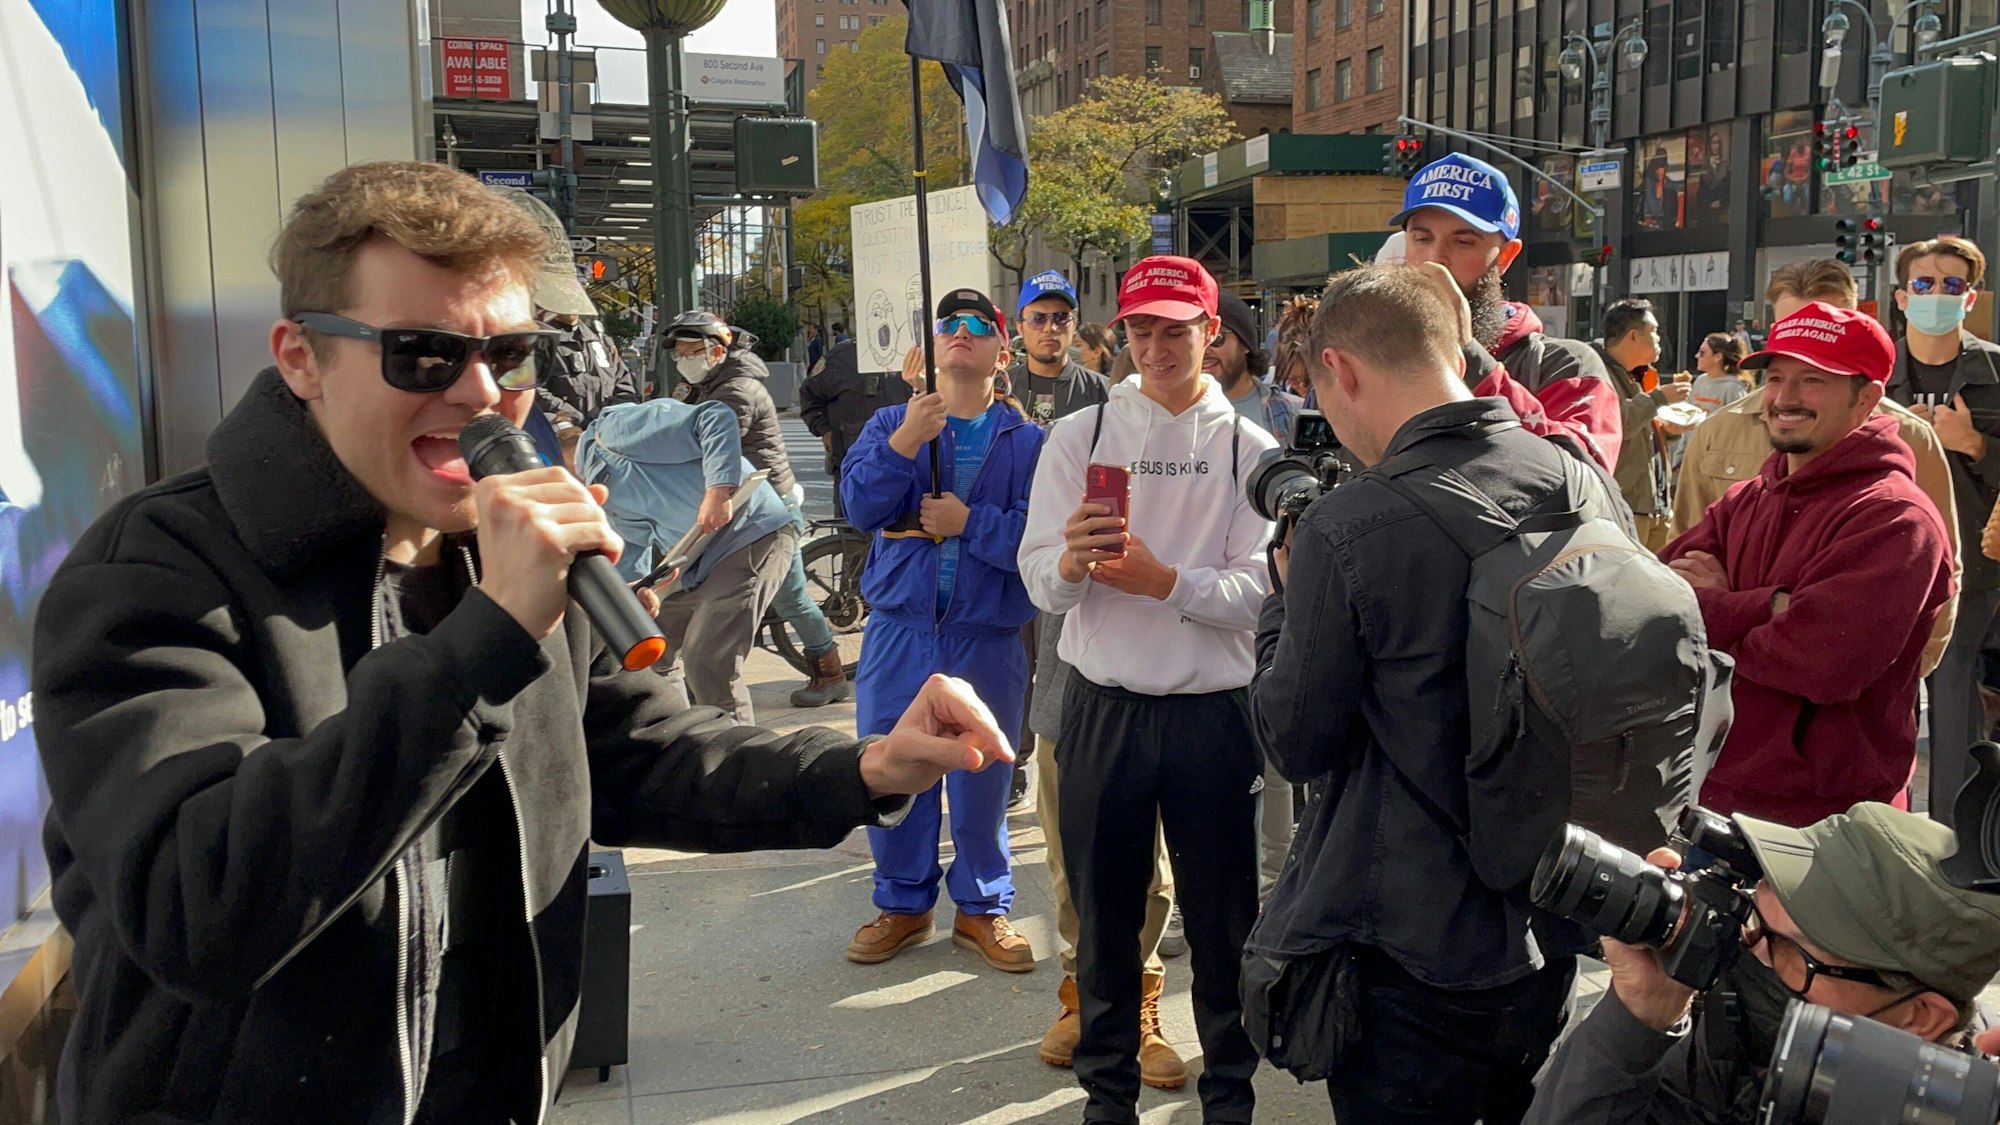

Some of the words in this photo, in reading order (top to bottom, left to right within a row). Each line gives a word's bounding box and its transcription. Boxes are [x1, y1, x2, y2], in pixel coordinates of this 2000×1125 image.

[446, 56, 507, 70] AVAILABLE
[703, 59, 718, 69] 800
[720, 60, 748, 71] Second
[749, 62, 764, 72] Ave
[1415, 164, 1493, 190] AMERICA
[1847, 165, 1863, 178] 42
[1866, 164, 1880, 177] St
[485, 174, 526, 186] Second
[1421, 181, 1474, 201] FIRST
[898, 199, 916, 219] THE
[1145, 267, 1189, 280] AMERICA
[1030, 274, 1071, 289] AMERICA
[1039, 282, 1065, 291] FIRST
[1151, 277, 1184, 287] AGAIN
[1798, 317, 1847, 336] AMERICA
[1775, 328, 1803, 340] GREAT
[1801, 328, 1839, 344] AGAIN
[1166, 462, 1177, 476] IS
[1180, 460, 1209, 475] KING
